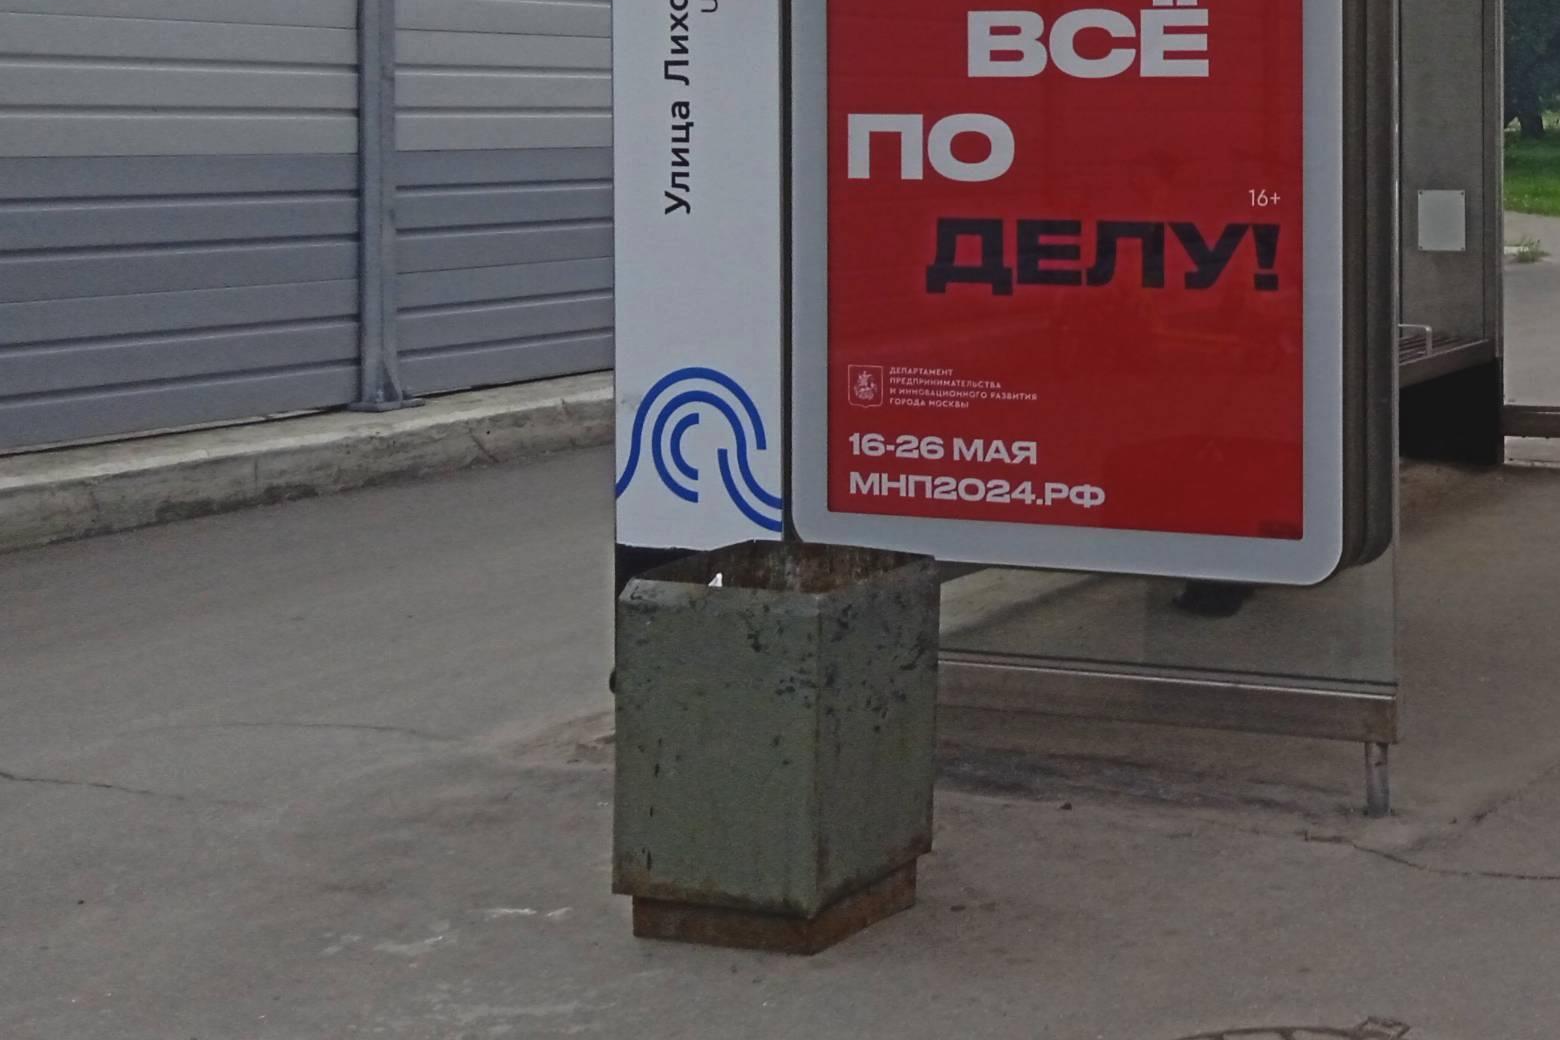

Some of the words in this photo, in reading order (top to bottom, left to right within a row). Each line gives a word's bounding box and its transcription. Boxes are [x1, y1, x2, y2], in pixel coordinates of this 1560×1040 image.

[664, 101, 694, 214] Улица
[847, 113, 1016, 182] ПО
[1248, 189, 1282, 208] 16+
[925, 217, 1281, 296] ДЕЛУ!
[889, 366, 954, 377] ДЕПАРТАМЕНТ
[889, 376, 1002, 390] ПРЕДПРИНИМАТЕЛЬСТВА
[889, 397, 927, 407] ГОРОДА
[928, 400, 970, 409] МОСКВЫ
[898, 388, 988, 400] ИННОВАЦИОННОГО
[990, 391, 1038, 401] РАЗВИТИЯ
[849, 432, 945, 460] 16-26
[953, 437, 1037, 465] МАЯ
[850, 471, 1106, 508] МНП2024.РФ
